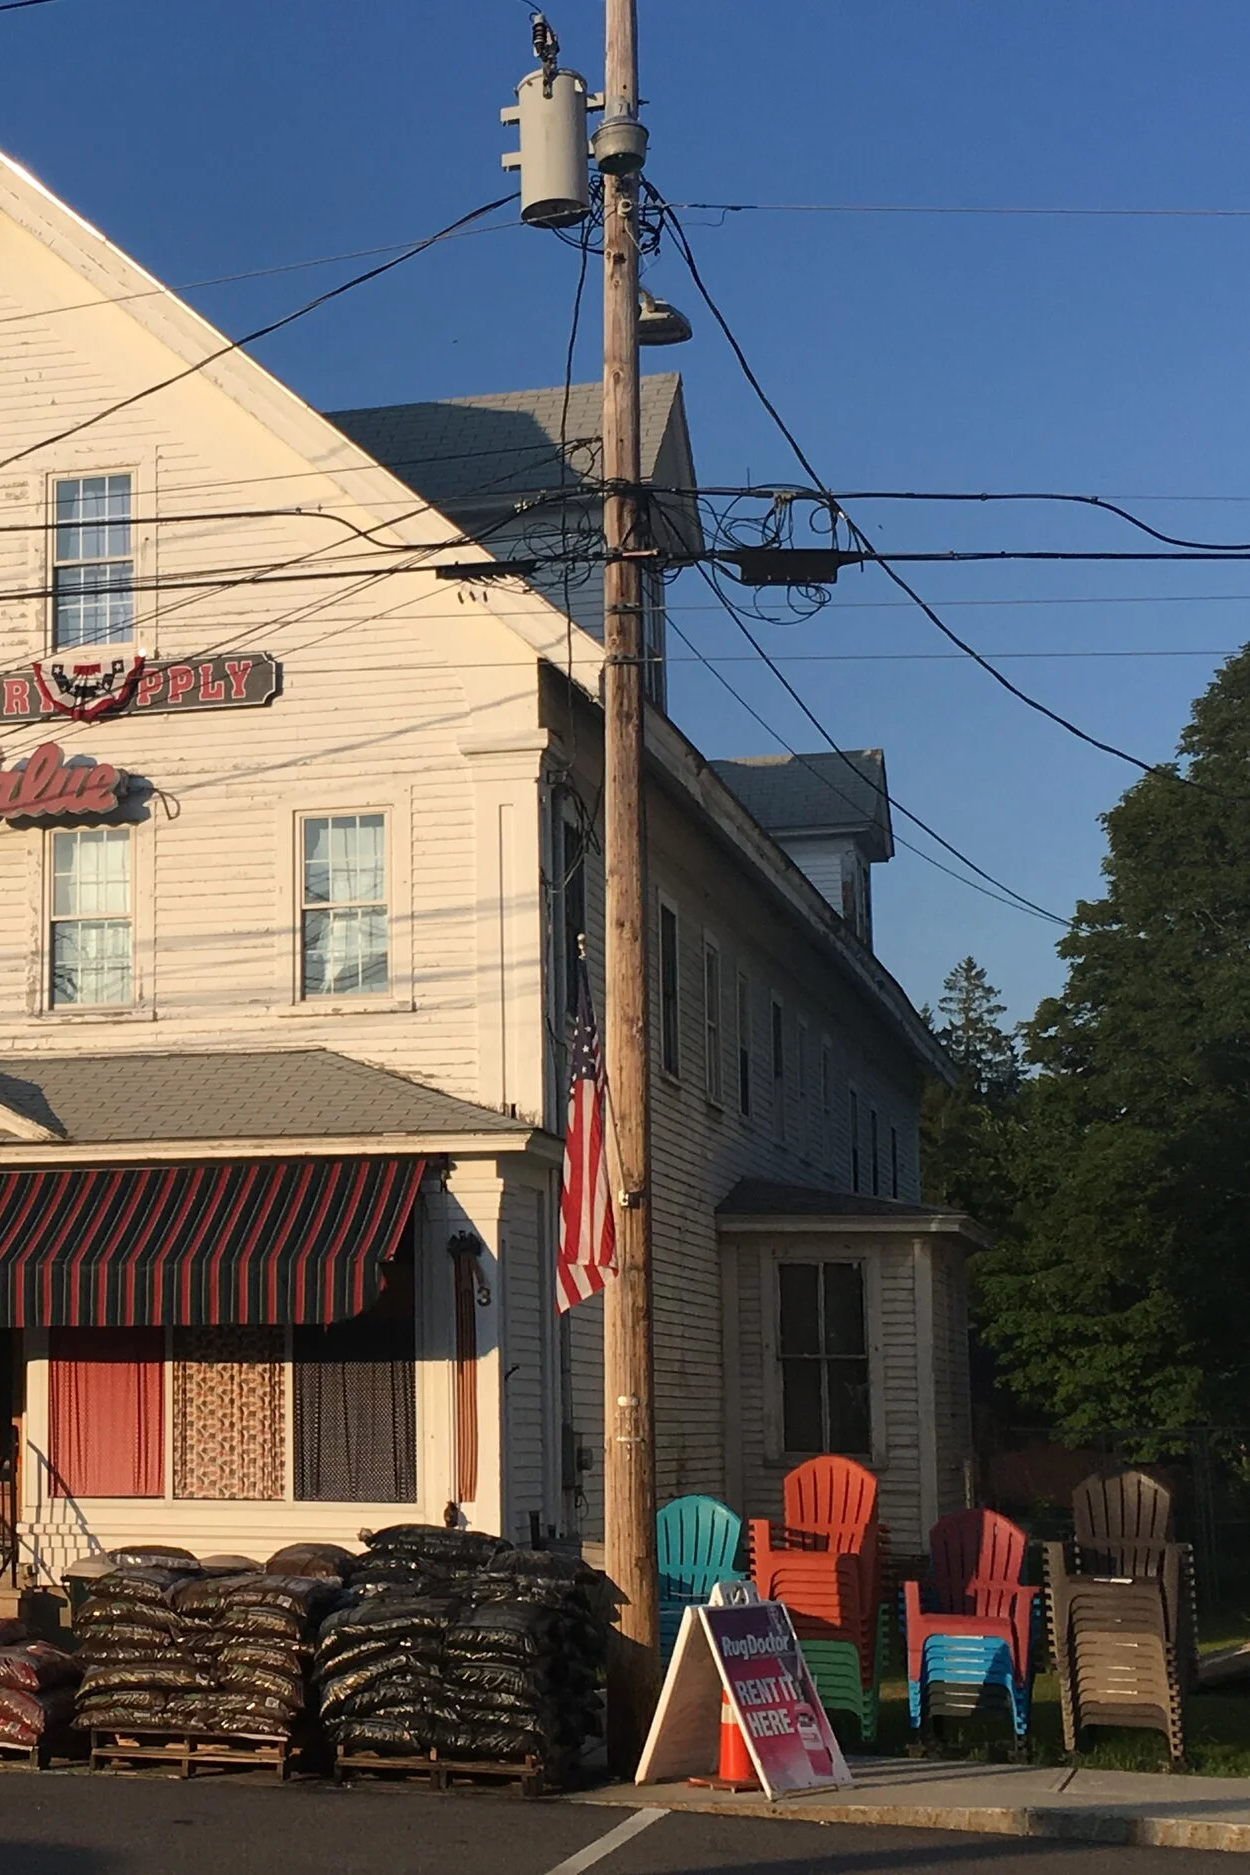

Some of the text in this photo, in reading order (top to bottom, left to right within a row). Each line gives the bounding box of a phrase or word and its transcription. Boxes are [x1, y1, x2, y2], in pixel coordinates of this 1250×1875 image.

[136, 659, 254, 706] PPLY
[734, 1675, 798, 1706] RENT IT
[746, 1708, 795, 1738] HERE
